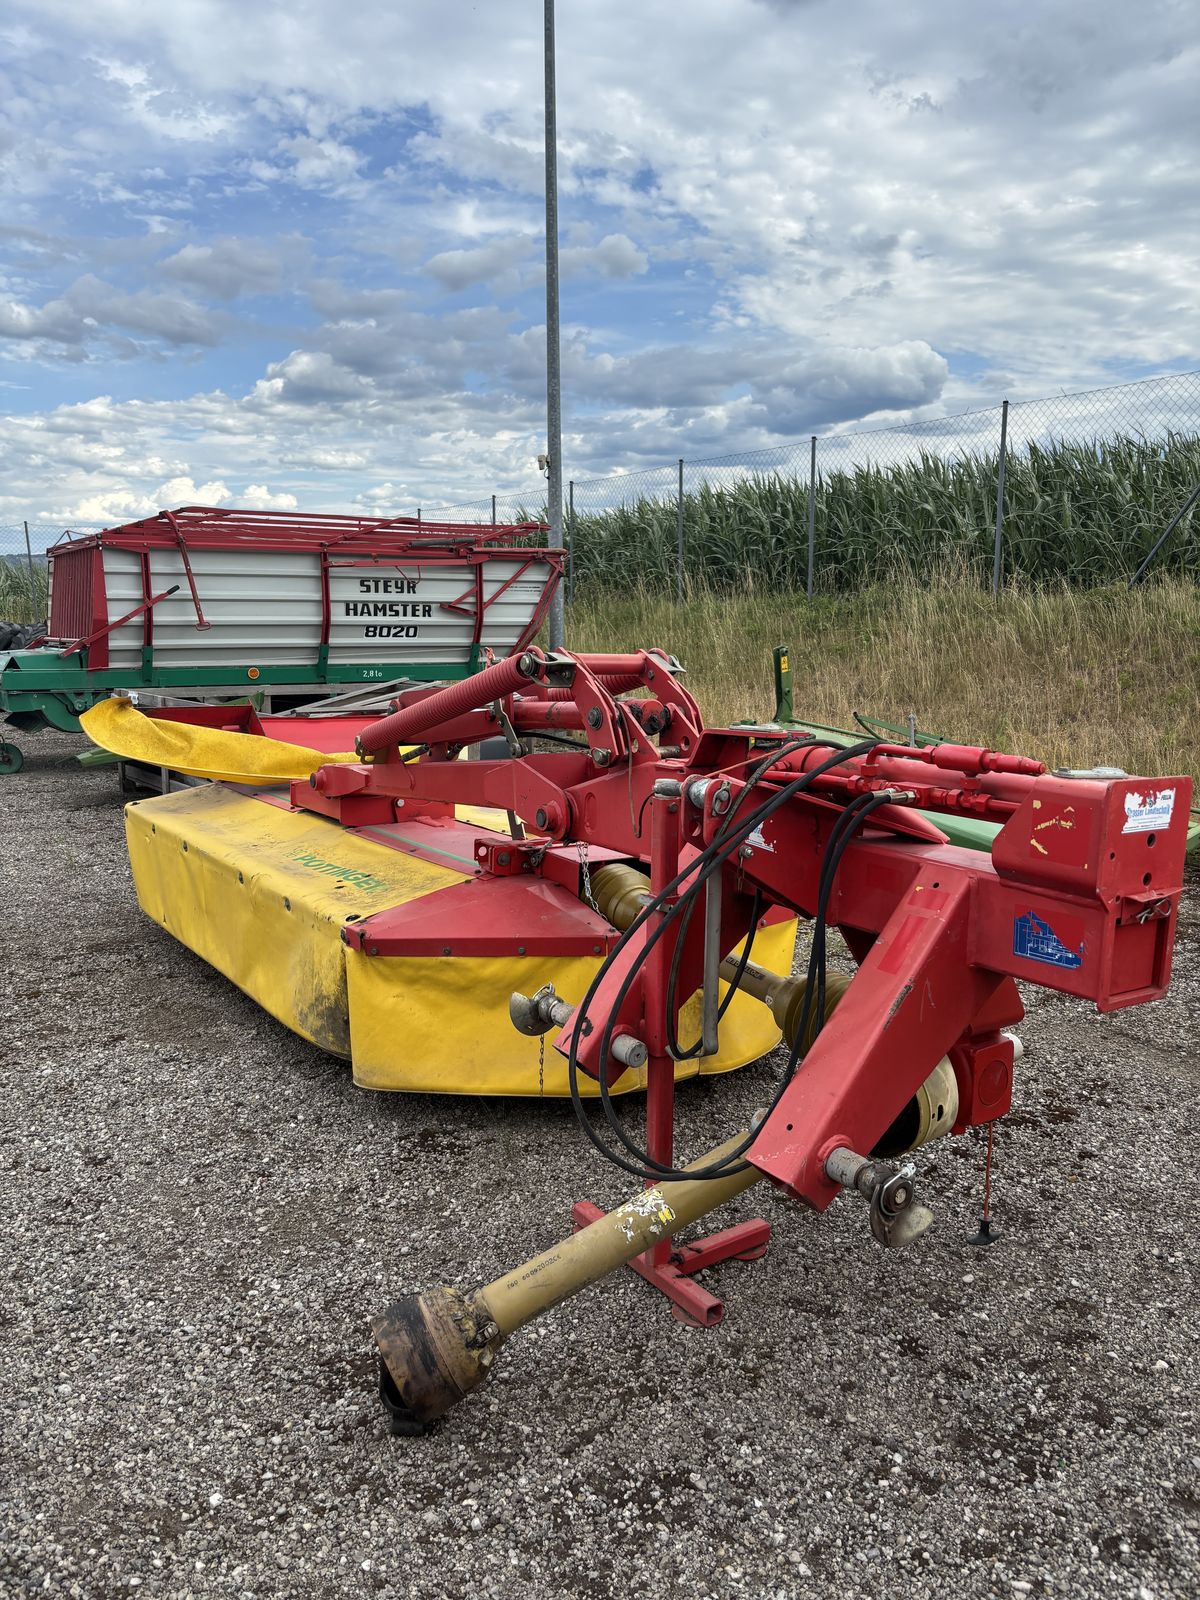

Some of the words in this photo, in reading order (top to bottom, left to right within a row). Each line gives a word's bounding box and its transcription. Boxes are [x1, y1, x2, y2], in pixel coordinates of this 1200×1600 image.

[360, 579, 417, 594] STEYR
[345, 603, 432, 618] HAMSTER
[364, 625, 418, 638] 8020
